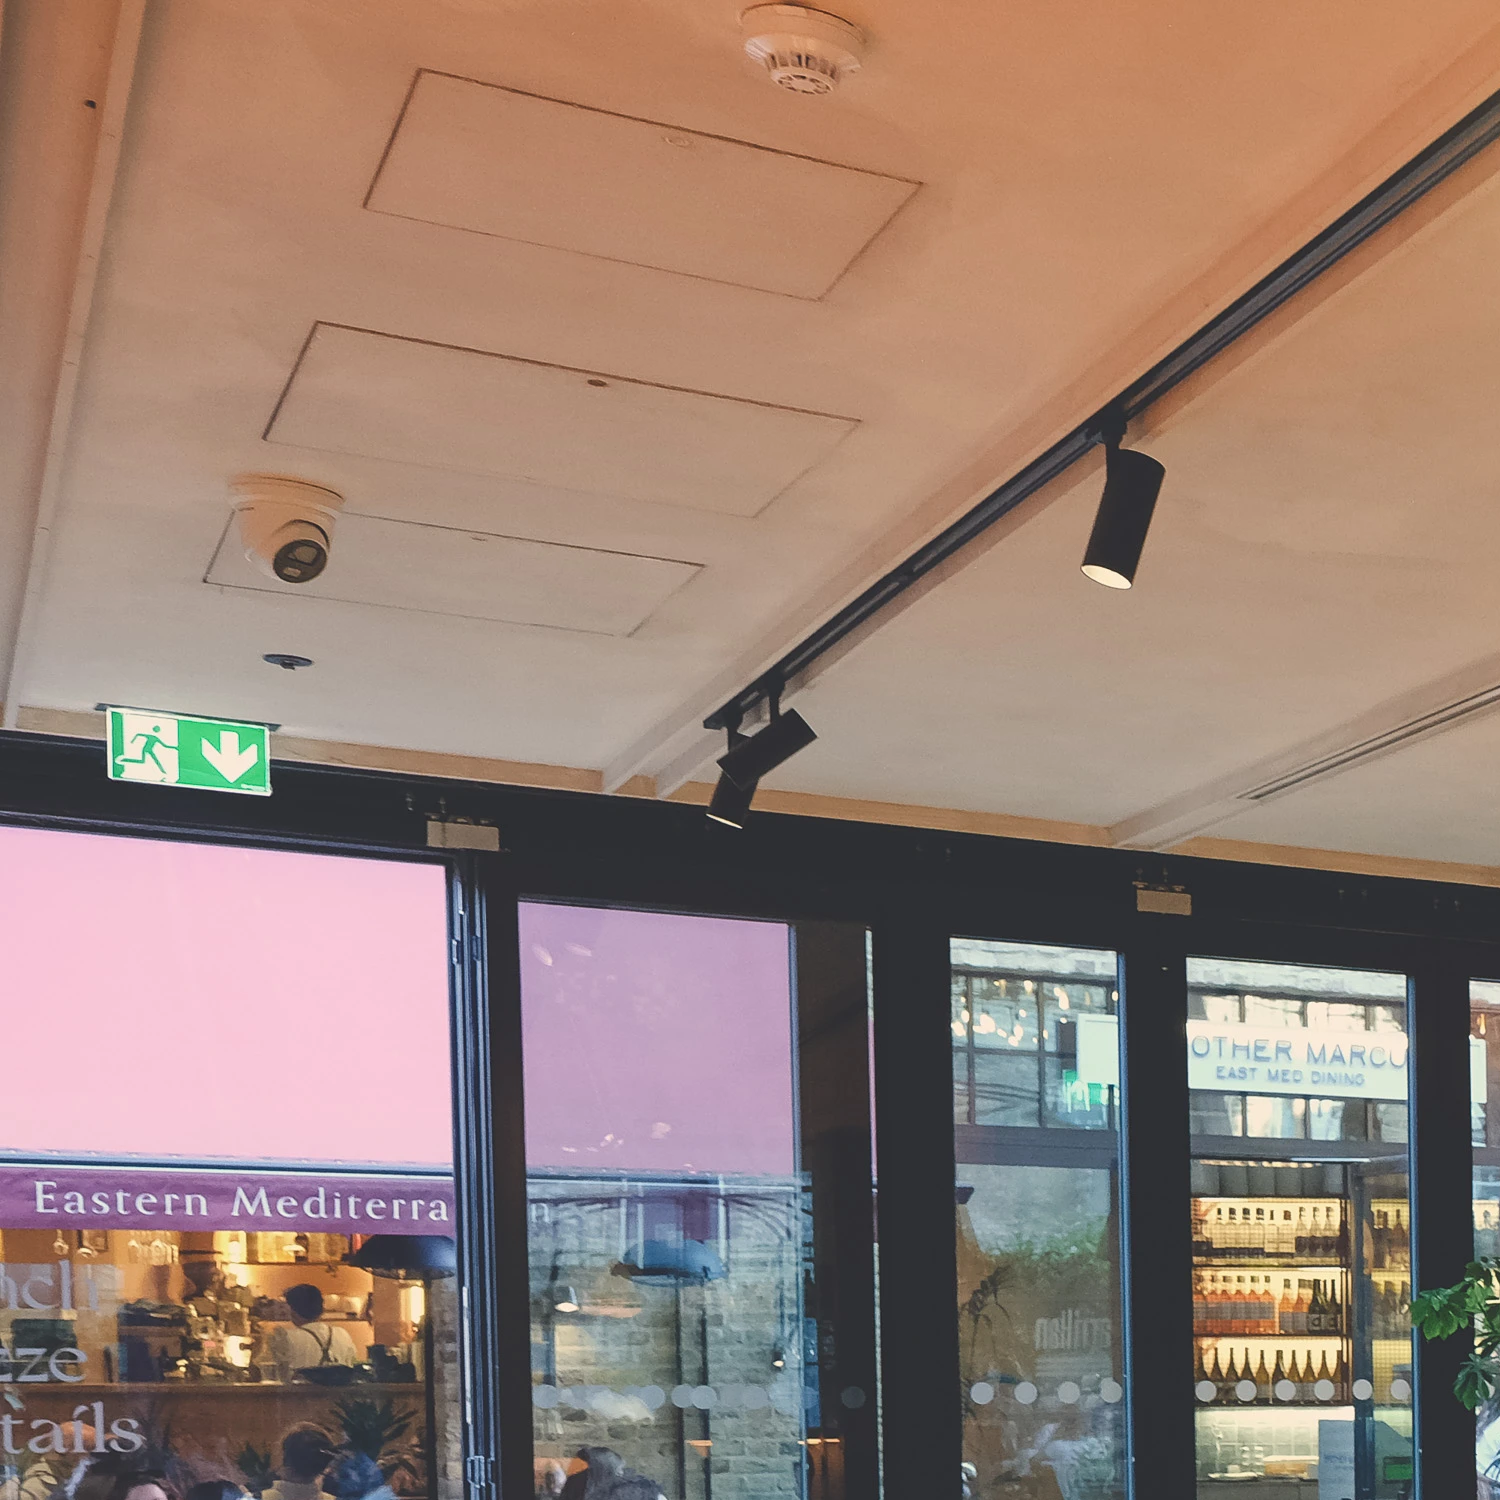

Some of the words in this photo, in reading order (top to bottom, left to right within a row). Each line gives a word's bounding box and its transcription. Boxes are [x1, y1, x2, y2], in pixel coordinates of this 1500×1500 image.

[1191, 1036, 1293, 1062] OTHER
[1215, 1066, 1258, 1080] EAST
[1267, 1069, 1303, 1083] MED
[1310, 1071, 1366, 1087] DINING
[34, 1180, 208, 1216] Eastern
